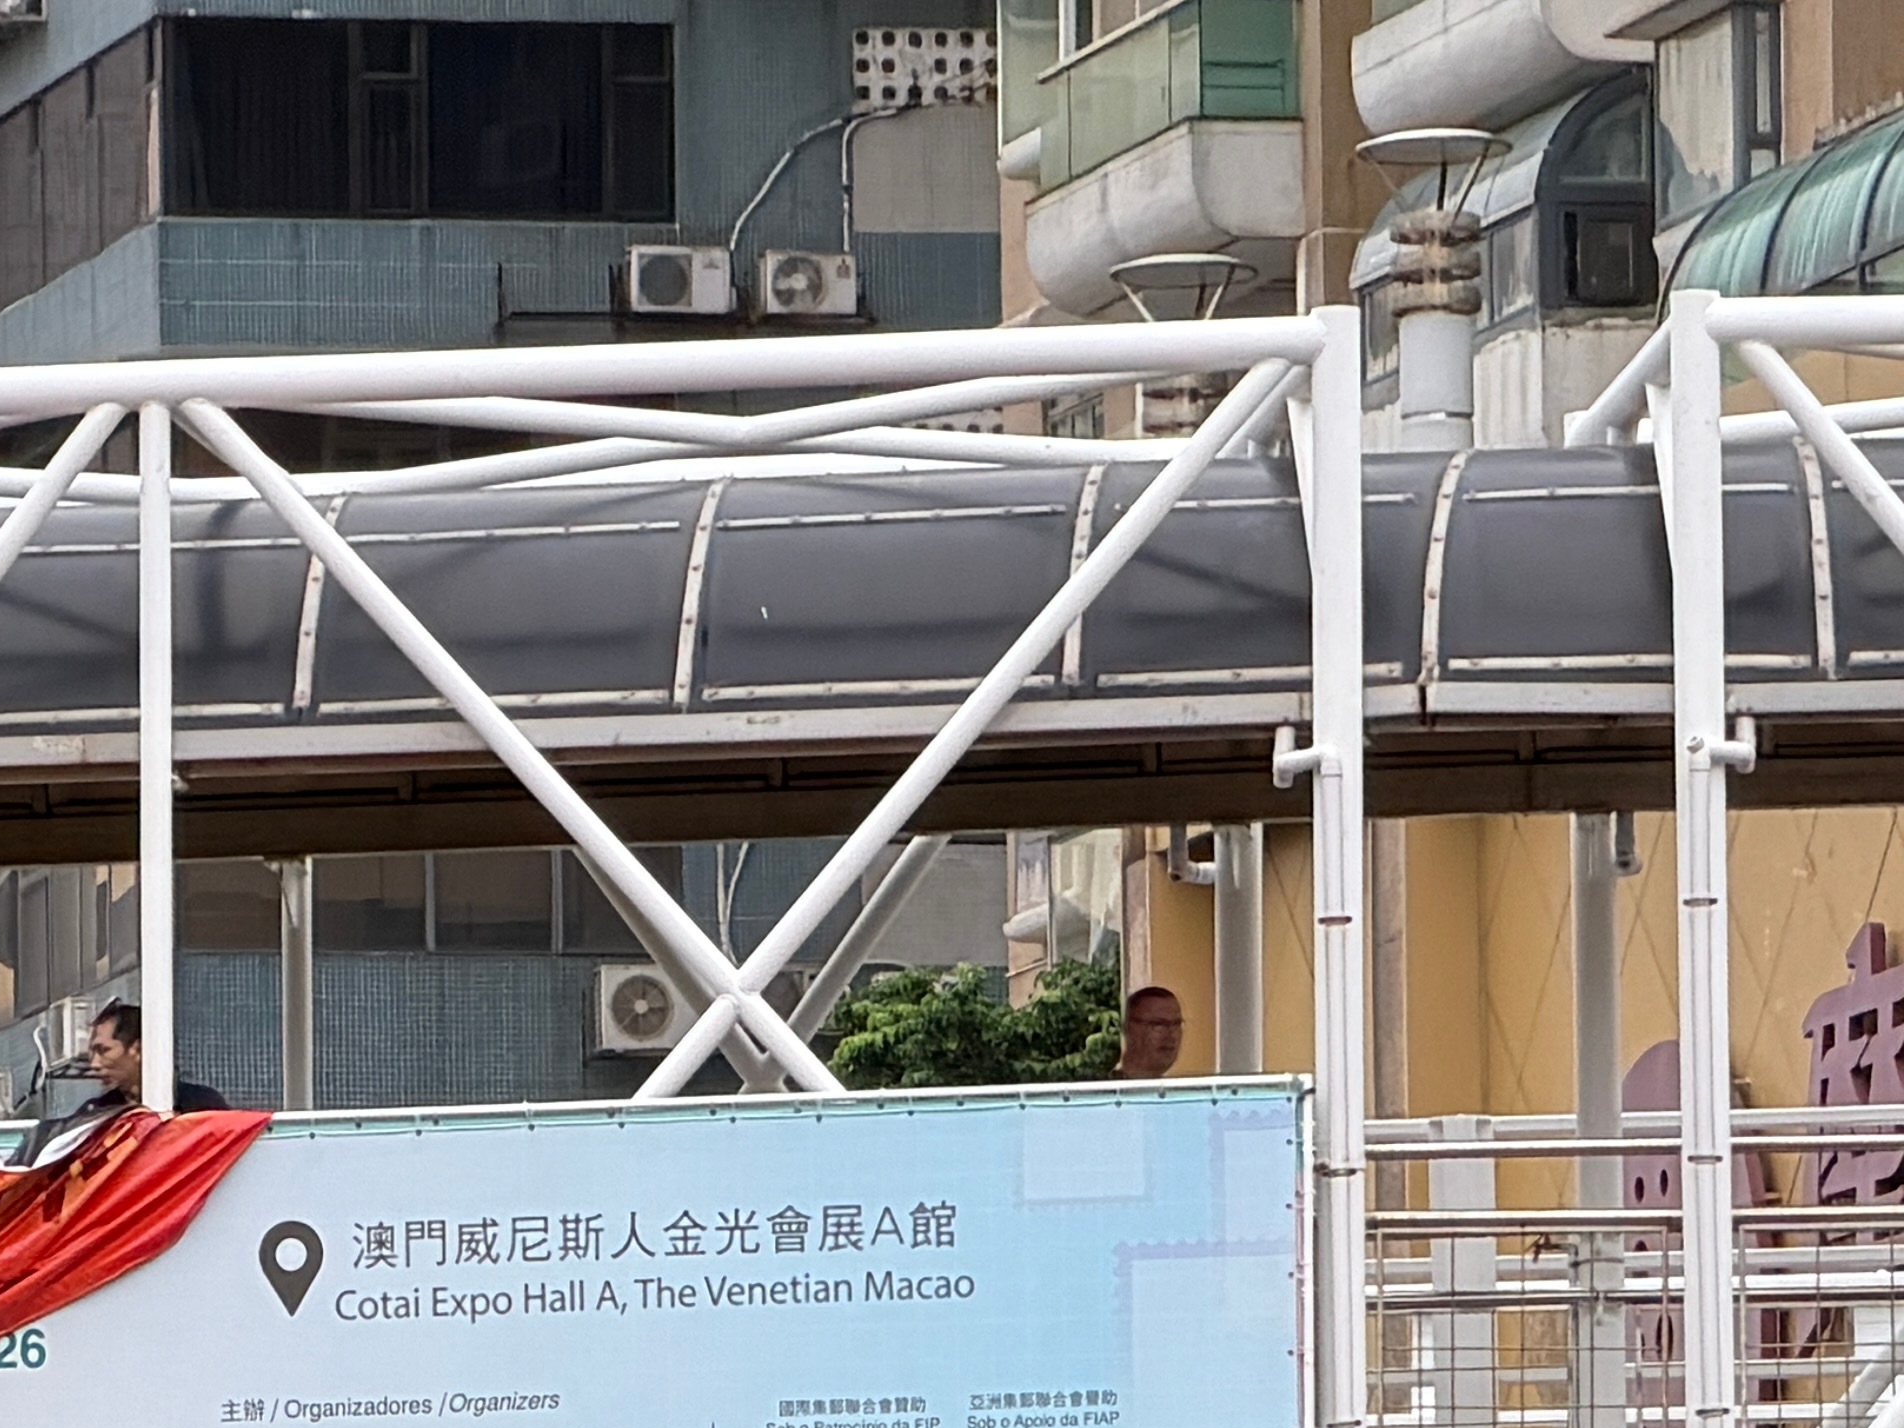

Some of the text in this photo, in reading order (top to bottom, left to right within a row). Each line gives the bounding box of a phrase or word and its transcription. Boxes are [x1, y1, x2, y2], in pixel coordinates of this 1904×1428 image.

[351, 1200, 957, 1269] 澳門威尼斯人金光會展A館
[335, 1270, 975, 1324] Cotai Expo Hall A, The Venetian Macao
[220, 1399, 265, 1423] 主辦
[284, 1393, 433, 1422] Organizadores
[1000, 1417, 1011, 1428] o
[1059, 1412, 1079, 1427] da
[1083, 1410, 1120, 1426] FIAP
